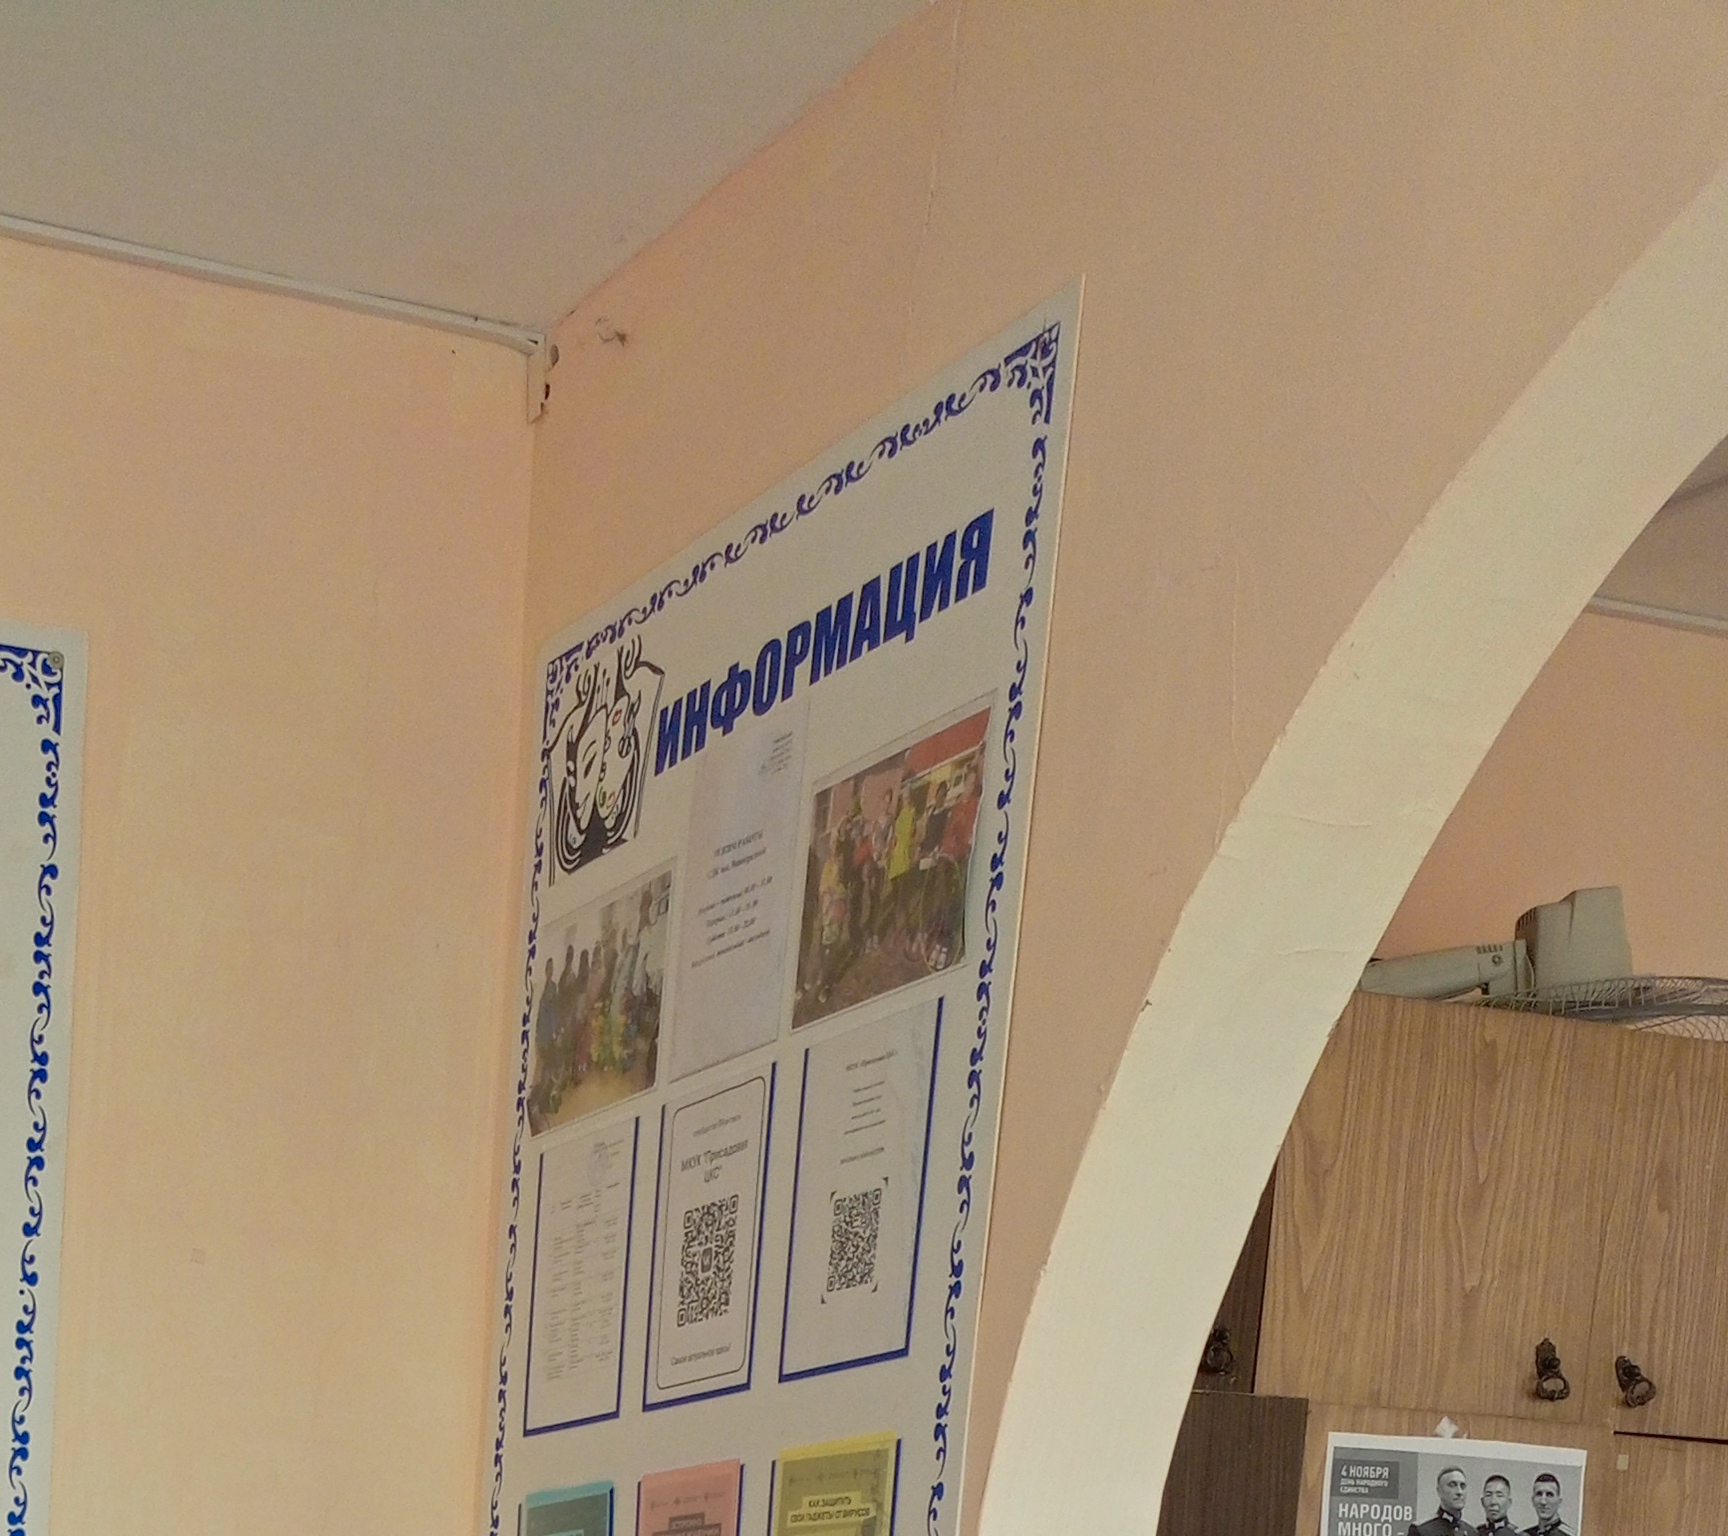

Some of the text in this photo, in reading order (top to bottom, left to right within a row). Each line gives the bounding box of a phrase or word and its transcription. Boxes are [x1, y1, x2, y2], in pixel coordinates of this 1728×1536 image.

[654, 510, 995, 775] ИНФОРМАЦИЯ
[1341, 1464, 1389, 1479] 4 НОЯБРЯ
[1339, 1503, 1413, 1522] НАРОДОВ
